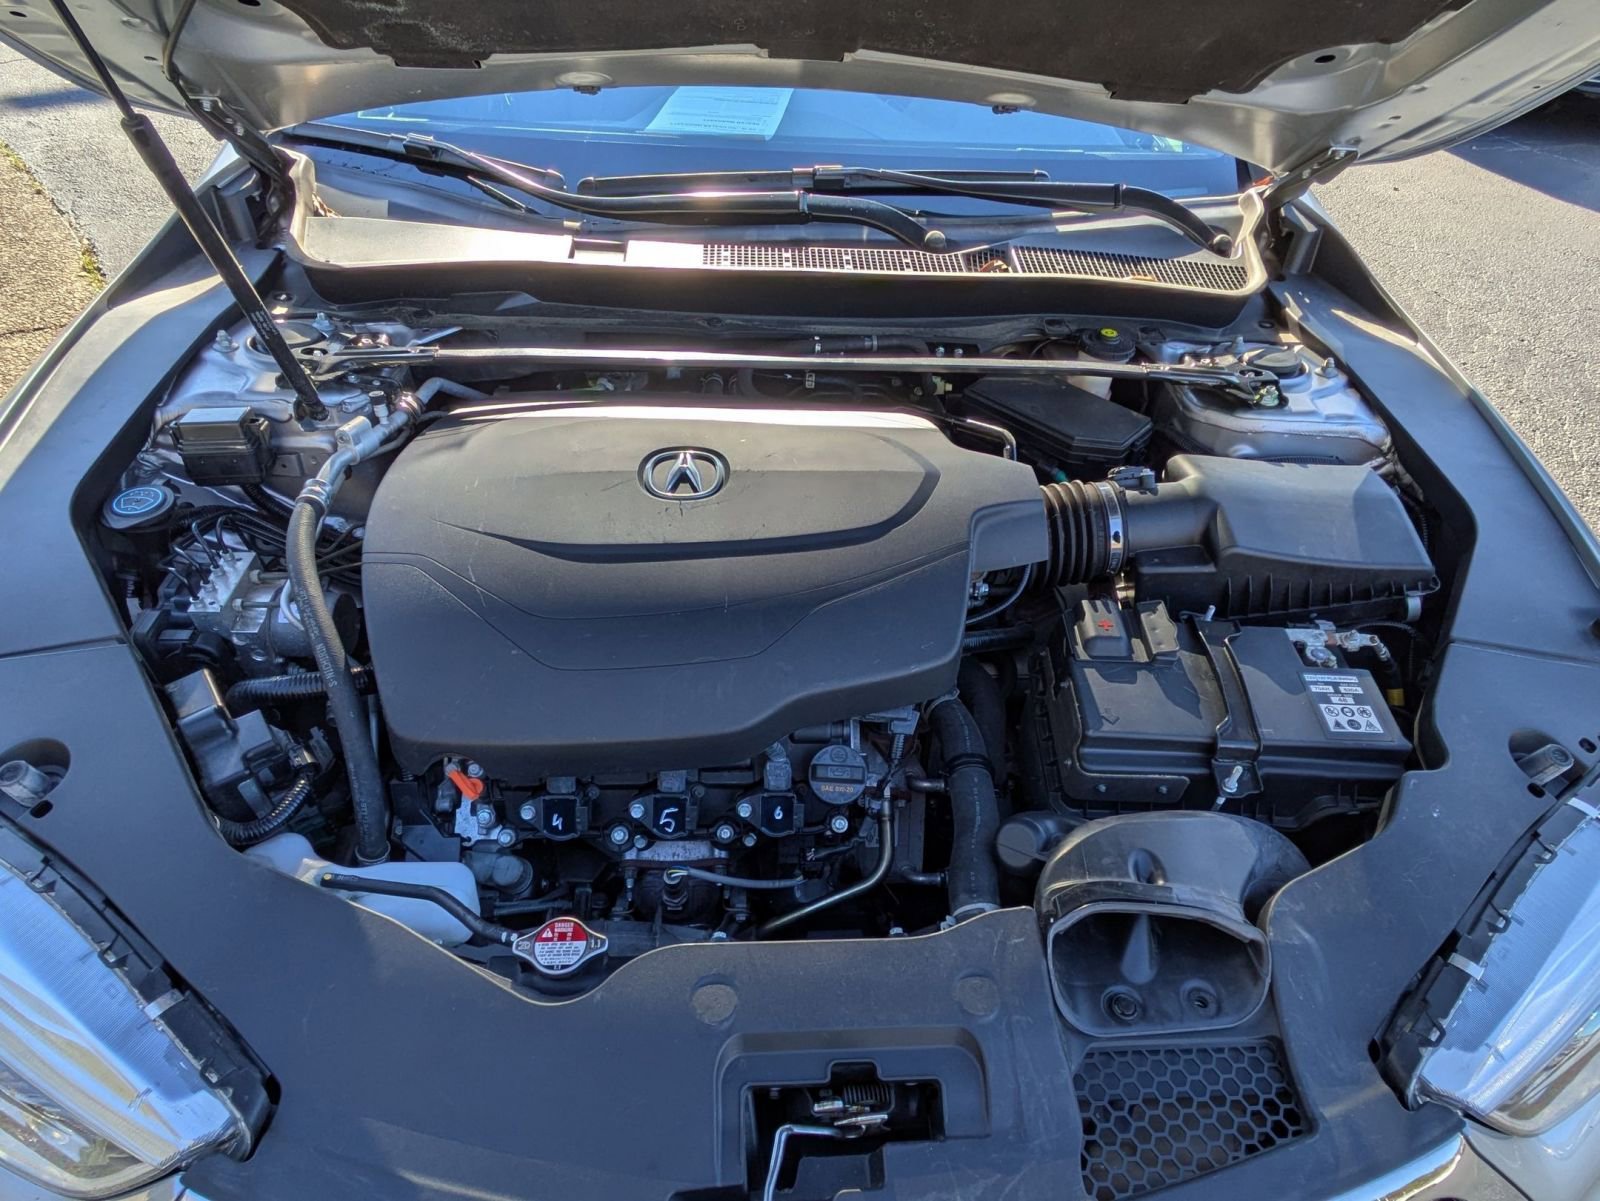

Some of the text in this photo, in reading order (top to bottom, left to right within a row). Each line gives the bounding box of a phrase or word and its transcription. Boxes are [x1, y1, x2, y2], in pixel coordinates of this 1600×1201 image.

[659, 807, 679, 832] 5
[773, 805, 783, 820] 6
[552, 813, 563, 831] 4
